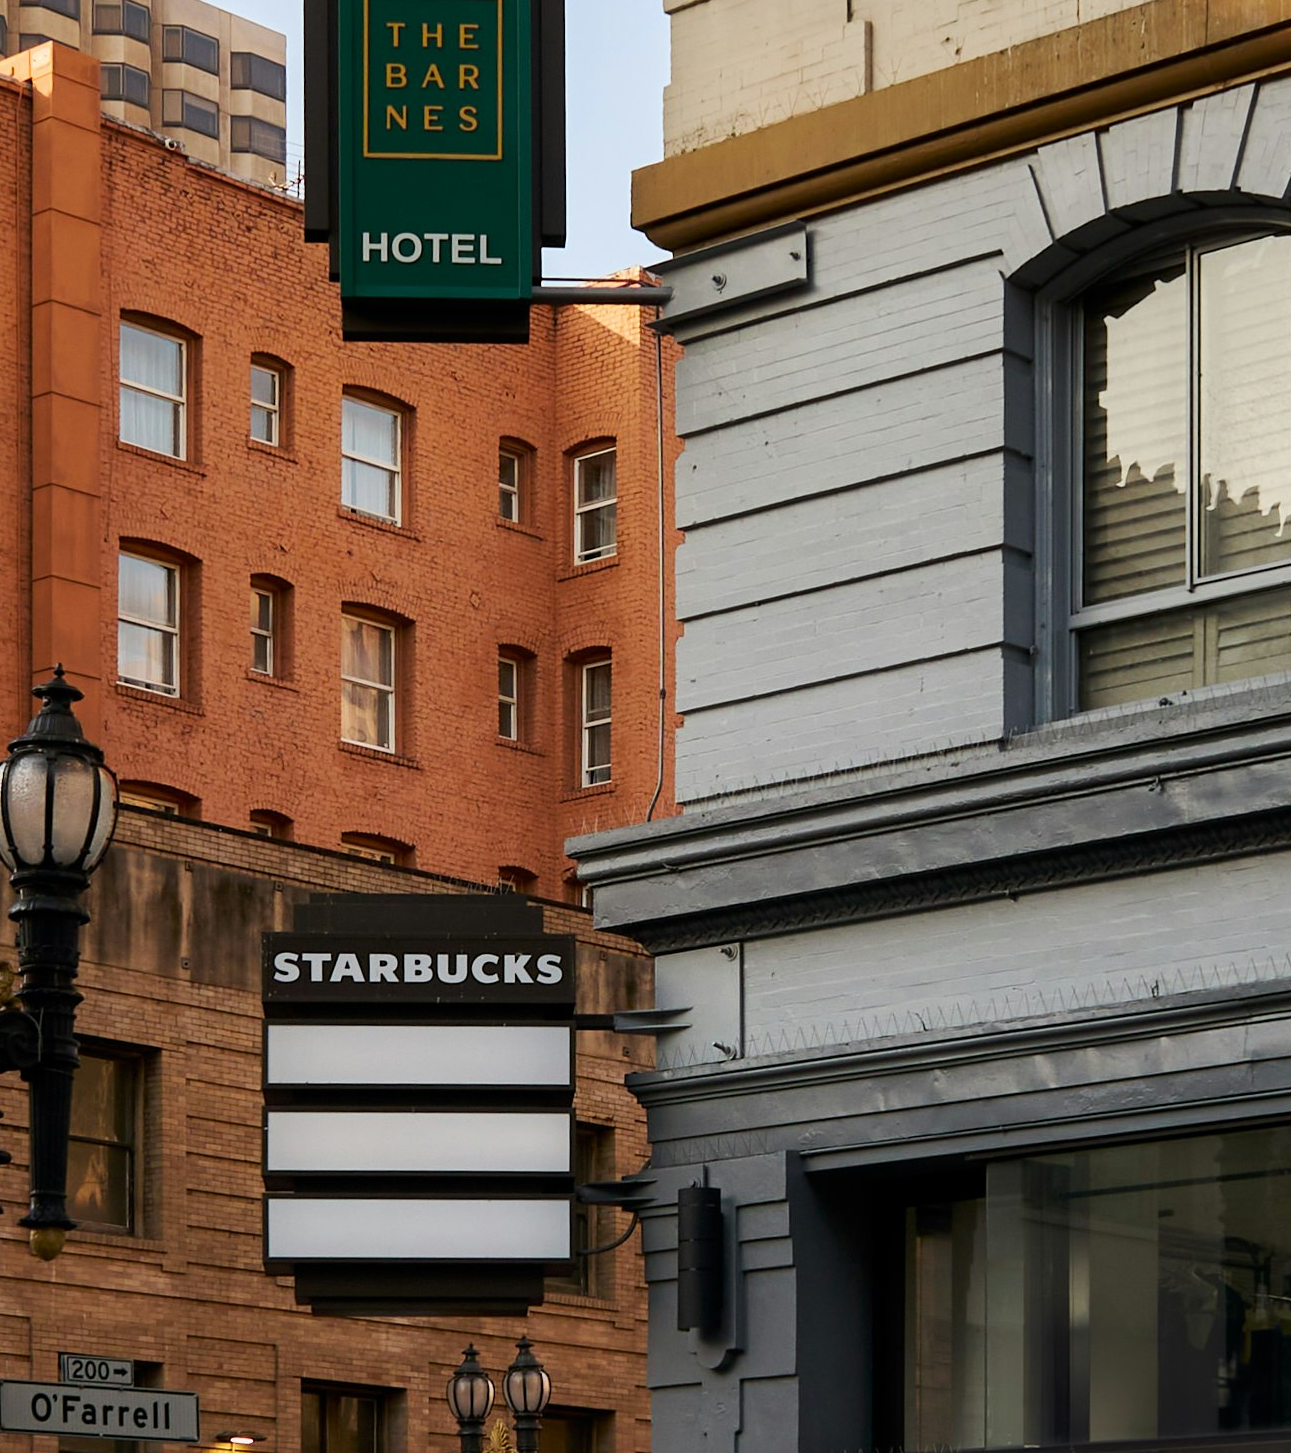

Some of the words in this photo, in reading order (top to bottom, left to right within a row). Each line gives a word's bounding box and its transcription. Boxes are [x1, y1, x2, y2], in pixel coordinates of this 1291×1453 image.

[386, 22, 480, 49] THE
[385, 63, 480, 90] BAR
[386, 105, 479, 132] NES
[362, 232, 503, 265] HOTEL
[272, 951, 564, 985] STARBUCKS
[71, 1359, 110, 1380] 200
[31, 1392, 170, 1430] O'Farrell
